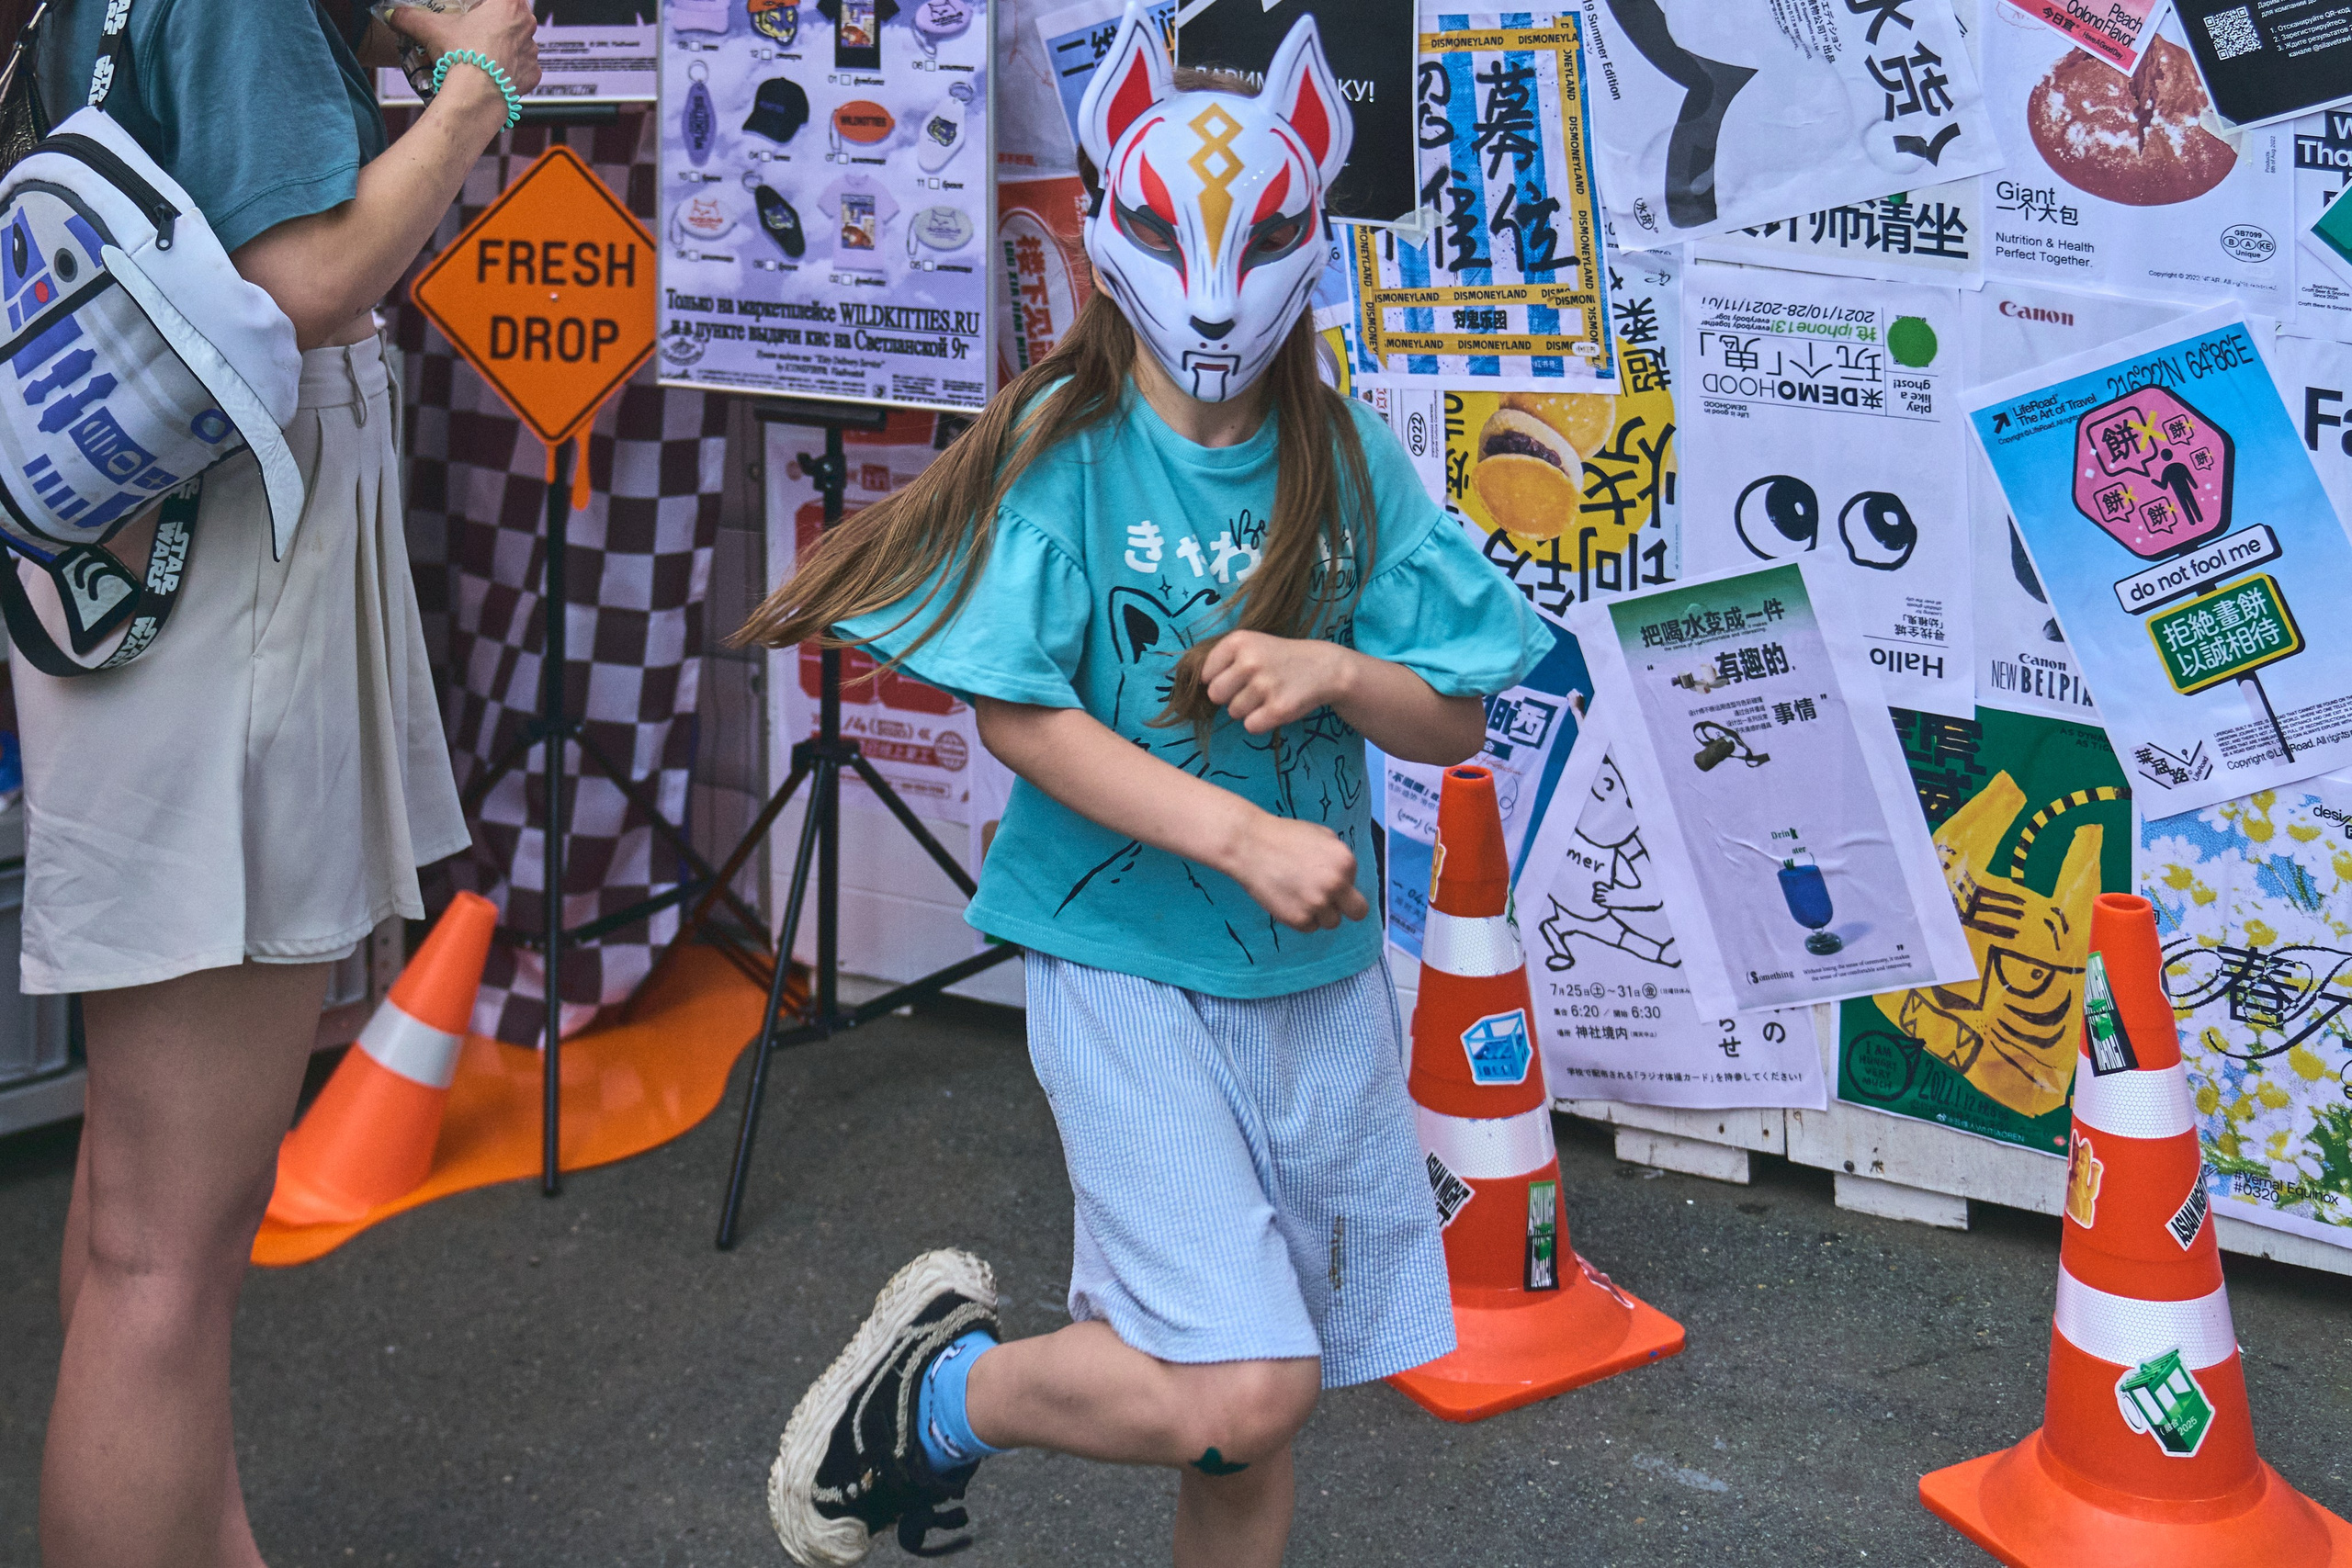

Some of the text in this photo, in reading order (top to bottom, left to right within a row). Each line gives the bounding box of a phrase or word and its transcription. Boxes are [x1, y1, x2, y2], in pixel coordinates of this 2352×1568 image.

[2109, 3, 2143, 34] Peach
[2261, 1, 2307, 18] для компании
[2278, 15, 2324, 32] Отсканируйте
[2324, 6, 2351, 17] QR-код
[2067, 0, 2135, 48] Oolong Flavor
[2281, 18, 2346, 40] Зарегистрируйтесь
[1430, 36, 1504, 48] DISMONEYLAND
[2082, 31, 2123, 60] Have Good Day
[2284, 39, 2307, 51] Ждите
[2308, 27, 2349, 44] результатов
[1589, 14, 1621, 101] Summer Edition
[2289, 47, 2312, 58] канале
[1569, 116, 1594, 289] DISMONEYLAND DISMONEYLAND
[1996, 181, 2055, 205] Giant
[1996, 201, 2078, 226] 一个大包
[1731, 199, 1969, 259] 师请坐
[2234, 230, 2262, 239] GB7099
[1996, 232, 2095, 253] Nutrition & Health
[2235, 250, 2261, 259] Unique
[476, 240, 636, 288] FRESH
[1996, 246, 2093, 267] Perfect Together.
[2148, 269, 2177, 279] Copyright
[1453, 289, 1527, 301] DISMONEYLAND
[665, 288, 979, 335] Только на маркетплейсе WILDKITTIES.RU
[1999, 300, 2075, 327] Canon
[1702, 320, 1770, 332] everybody together
[1770, 321, 1852, 340] iphone13!
[489, 316, 619, 363] DROP
[695, 322, 745, 344] пункте
[748, 325, 801, 345] выдачи
[805, 331, 831, 347] кис
[834, 333, 852, 349] на
[854, 330, 947, 358] Светланской
[952, 337, 969, 359] 9г
[1458, 340, 1532, 351] DISMONEYLAND
[1894, 378, 1930, 390] ghost!
[1704, 401, 1747, 410] DEMOHOOD
[1906, 402, 1931, 413] play
[1911, 392, 1931, 403] like
[2012, 396, 2055, 417] LifeRoad
[2018, 393, 2098, 426] The Art of Travel
[2304, 387, 2352, 457] F
[1412, 416, 1422, 453] 2022
[1997, 432, 2024, 446] Copyright
[147, 522, 177, 593] WARS
[160, 522, 190, 596] STAR
[2131, 538, 2261, 602] do not fool me
[1640, 597, 1785, 648] 把喝水变成一件
[2177, 616, 2280, 678] 以誠相待
[1870, 648, 1943, 679] Hallo
[2018, 652, 2067, 671] Canon
[1992, 660, 2018, 692] NEW
[2226, 752, 2267, 773] Copyright
[2265, 739, 2316, 761] ©LiRoad.
[2315, 735, 2327, 747] All
[1770, 828, 1799, 840] Drink
[1571, 1004, 1600, 1018] 6:20
[1631, 1005, 1661, 1019] 6:30
[1575, 1024, 1628, 1041] 神社境内
[1435, 1173, 1471, 1213] NIGHT
[2233, 1169, 2339, 1206] #Vernal Equinox
[2233, 1180, 2279, 1203] #0320
[2170, 1202, 2200, 1247] ASIAN
[2177, 1416, 2198, 1437] 2025
